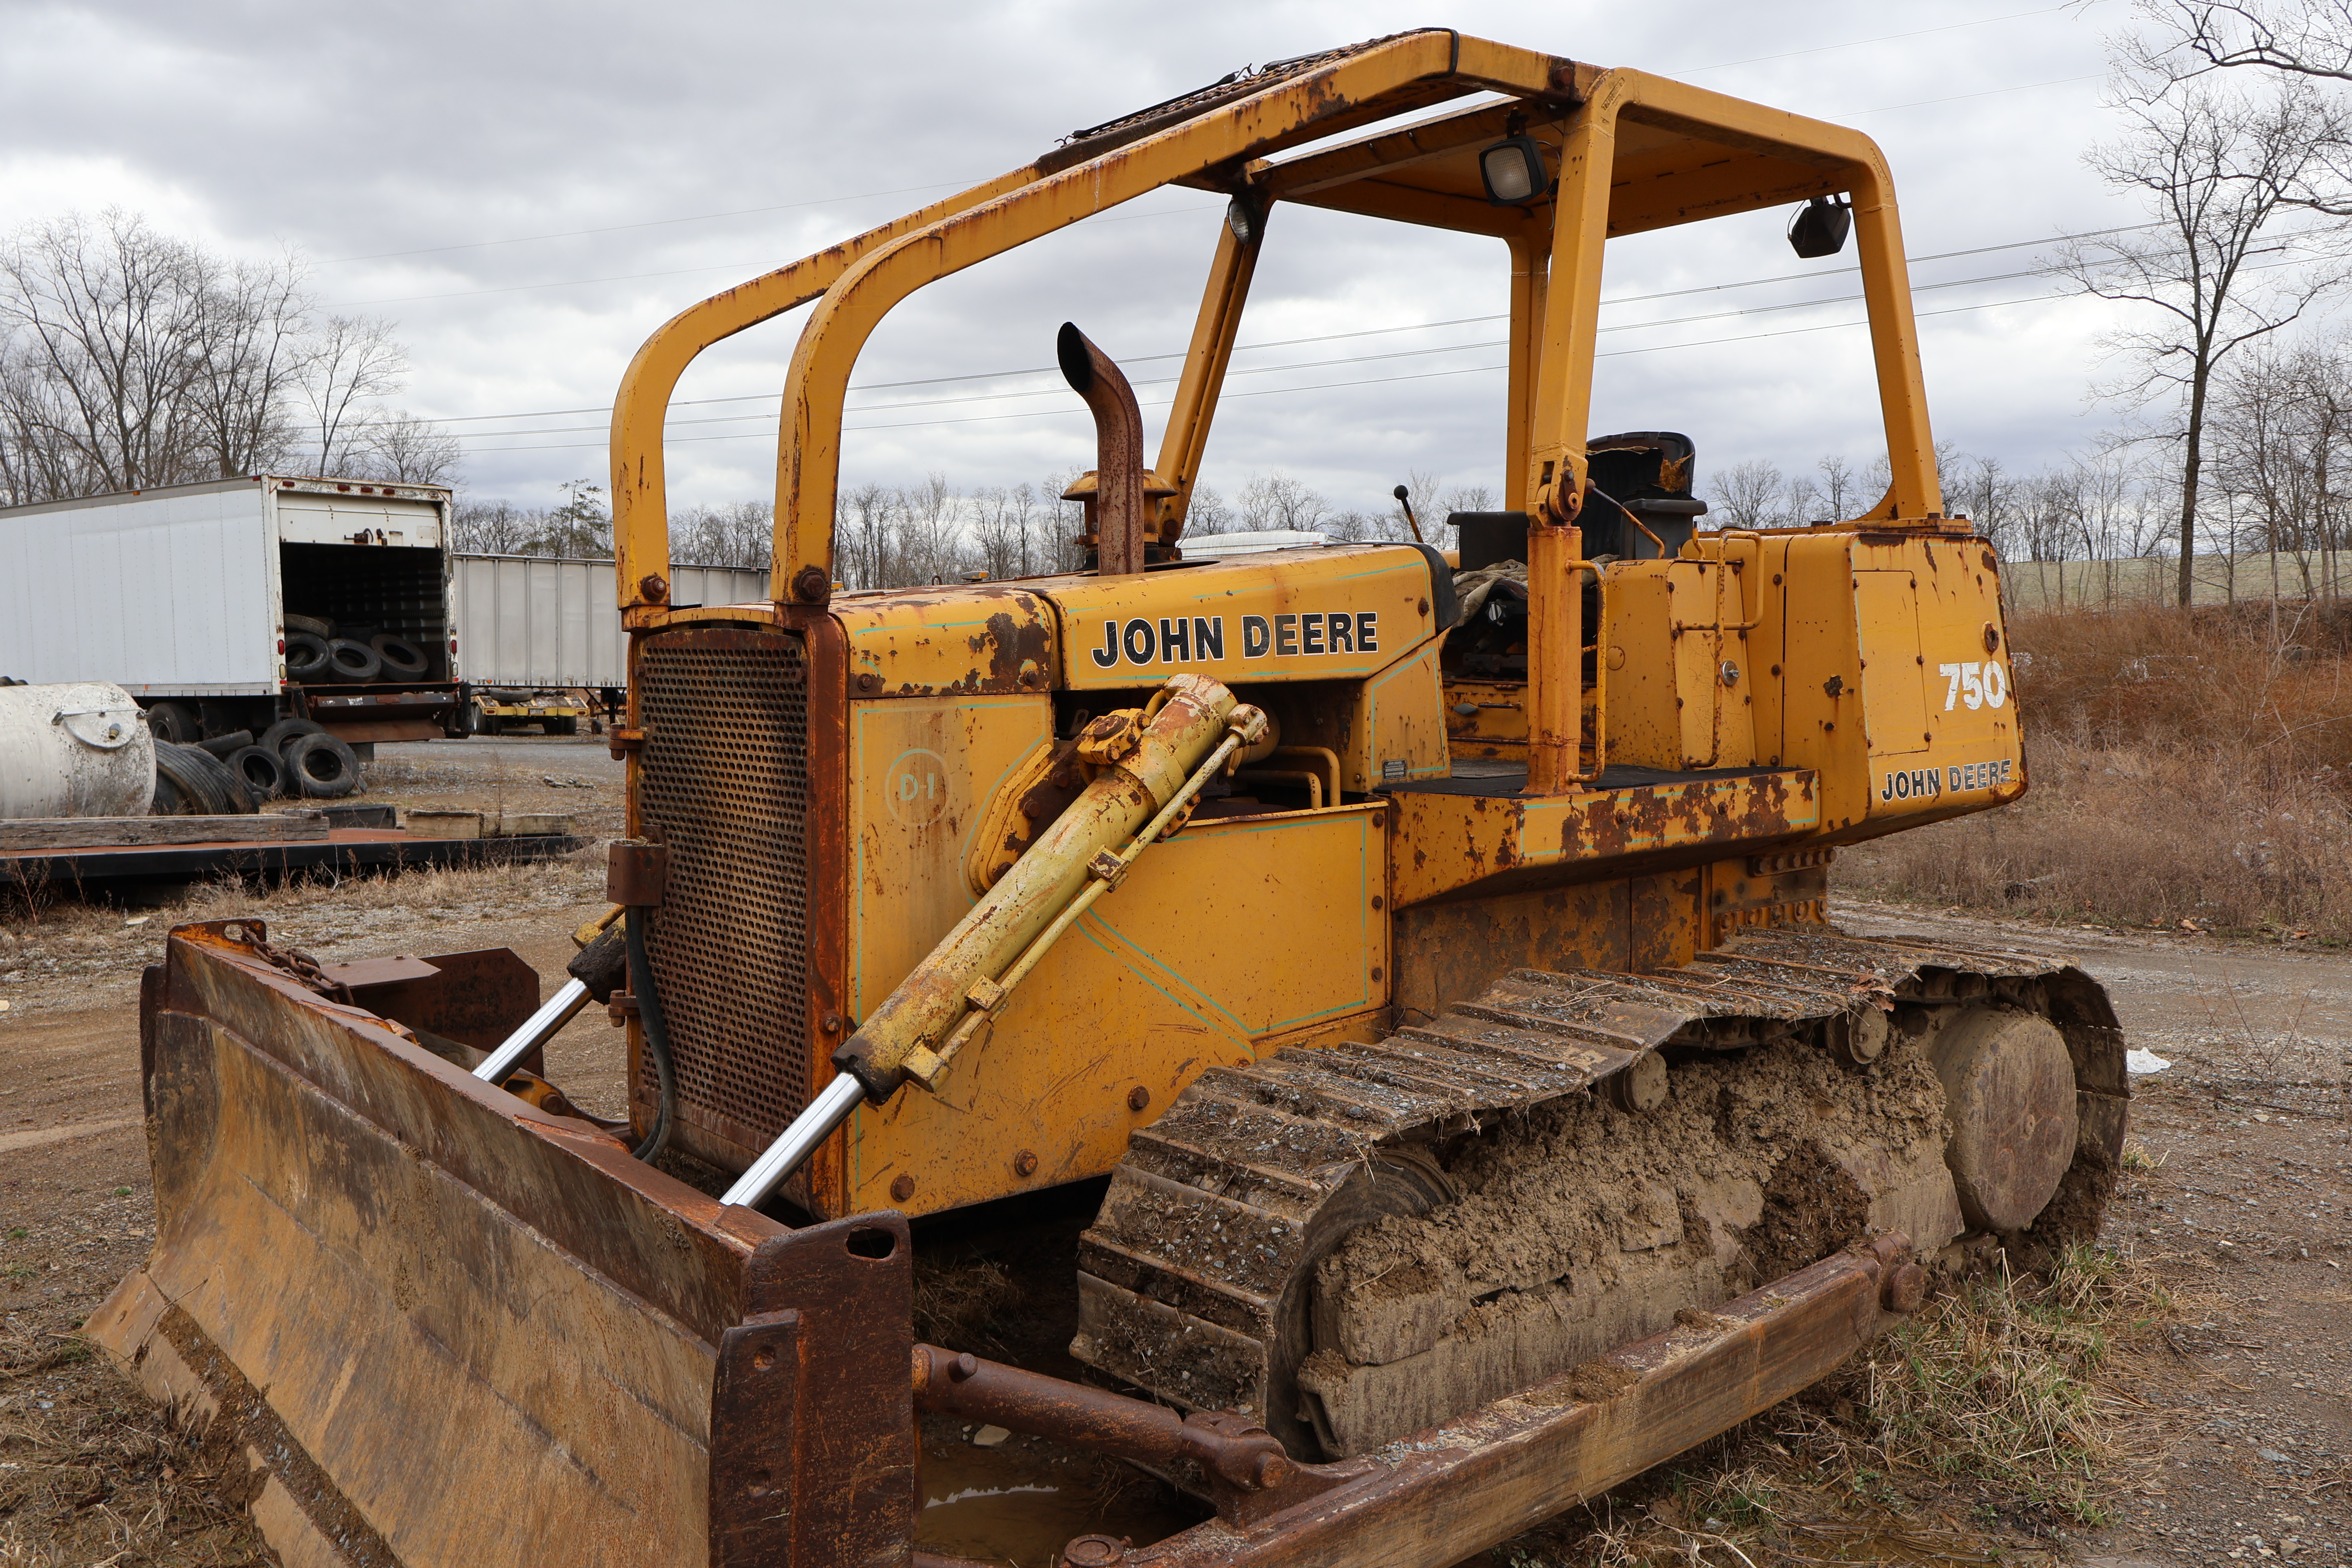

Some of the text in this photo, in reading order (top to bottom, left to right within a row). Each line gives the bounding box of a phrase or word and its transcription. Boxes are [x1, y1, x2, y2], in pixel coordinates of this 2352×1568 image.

[1091, 612, 1379, 669] JOHN DEERE
[1939, 661, 2005, 711] 750
[1881, 759, 2011, 802] JOHN DEERE
